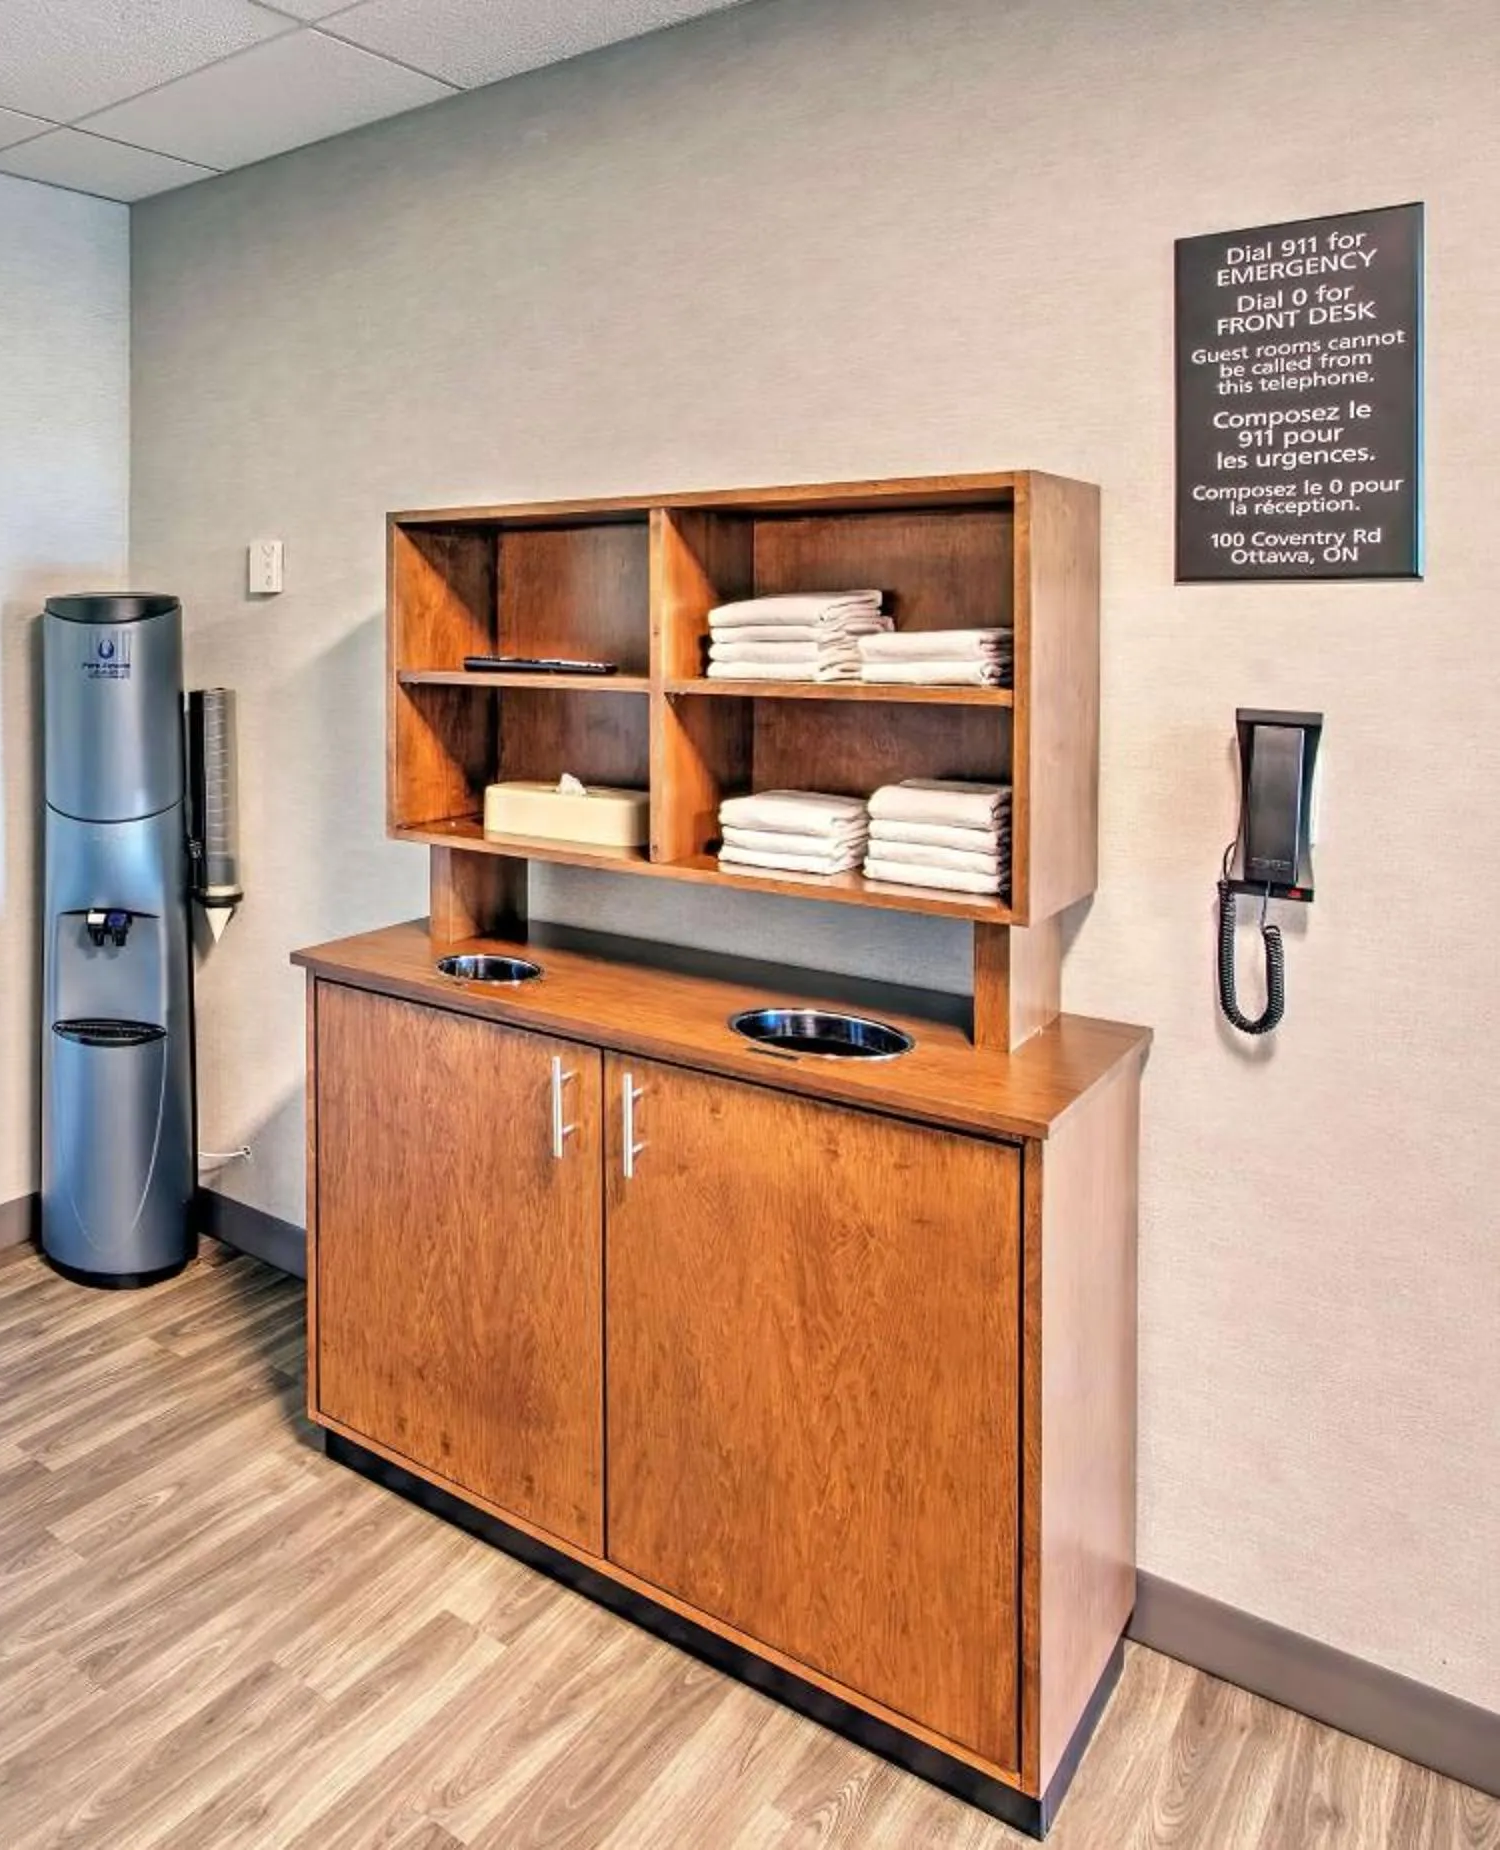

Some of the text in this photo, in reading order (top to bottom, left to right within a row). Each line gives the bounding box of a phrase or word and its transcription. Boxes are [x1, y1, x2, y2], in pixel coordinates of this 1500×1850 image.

[1226, 233, 1367, 264] Dial 911 for
[1216, 249, 1377, 286] EMERGENCY
[1236, 287, 1354, 313] Dial 0 for
[1216, 301, 1376, 335] FRONT DESK
[1190, 330, 1405, 363] Guest rooms cannot
[1219, 354, 1372, 379] be called from
[1216, 372, 1374, 395] this telephone.
[1212, 402, 1372, 428] Composez le
[1237, 429, 1344, 448] 911 pour
[1216, 449, 1375, 470] les urgences.
[1192, 478, 1404, 502] Composez le 0 pour
[1229, 497, 1360, 517] la réception.
[1210, 529, 1382, 548] 100 Coventry Rd
[1230, 547, 1359, 565] Ottawa, ON
